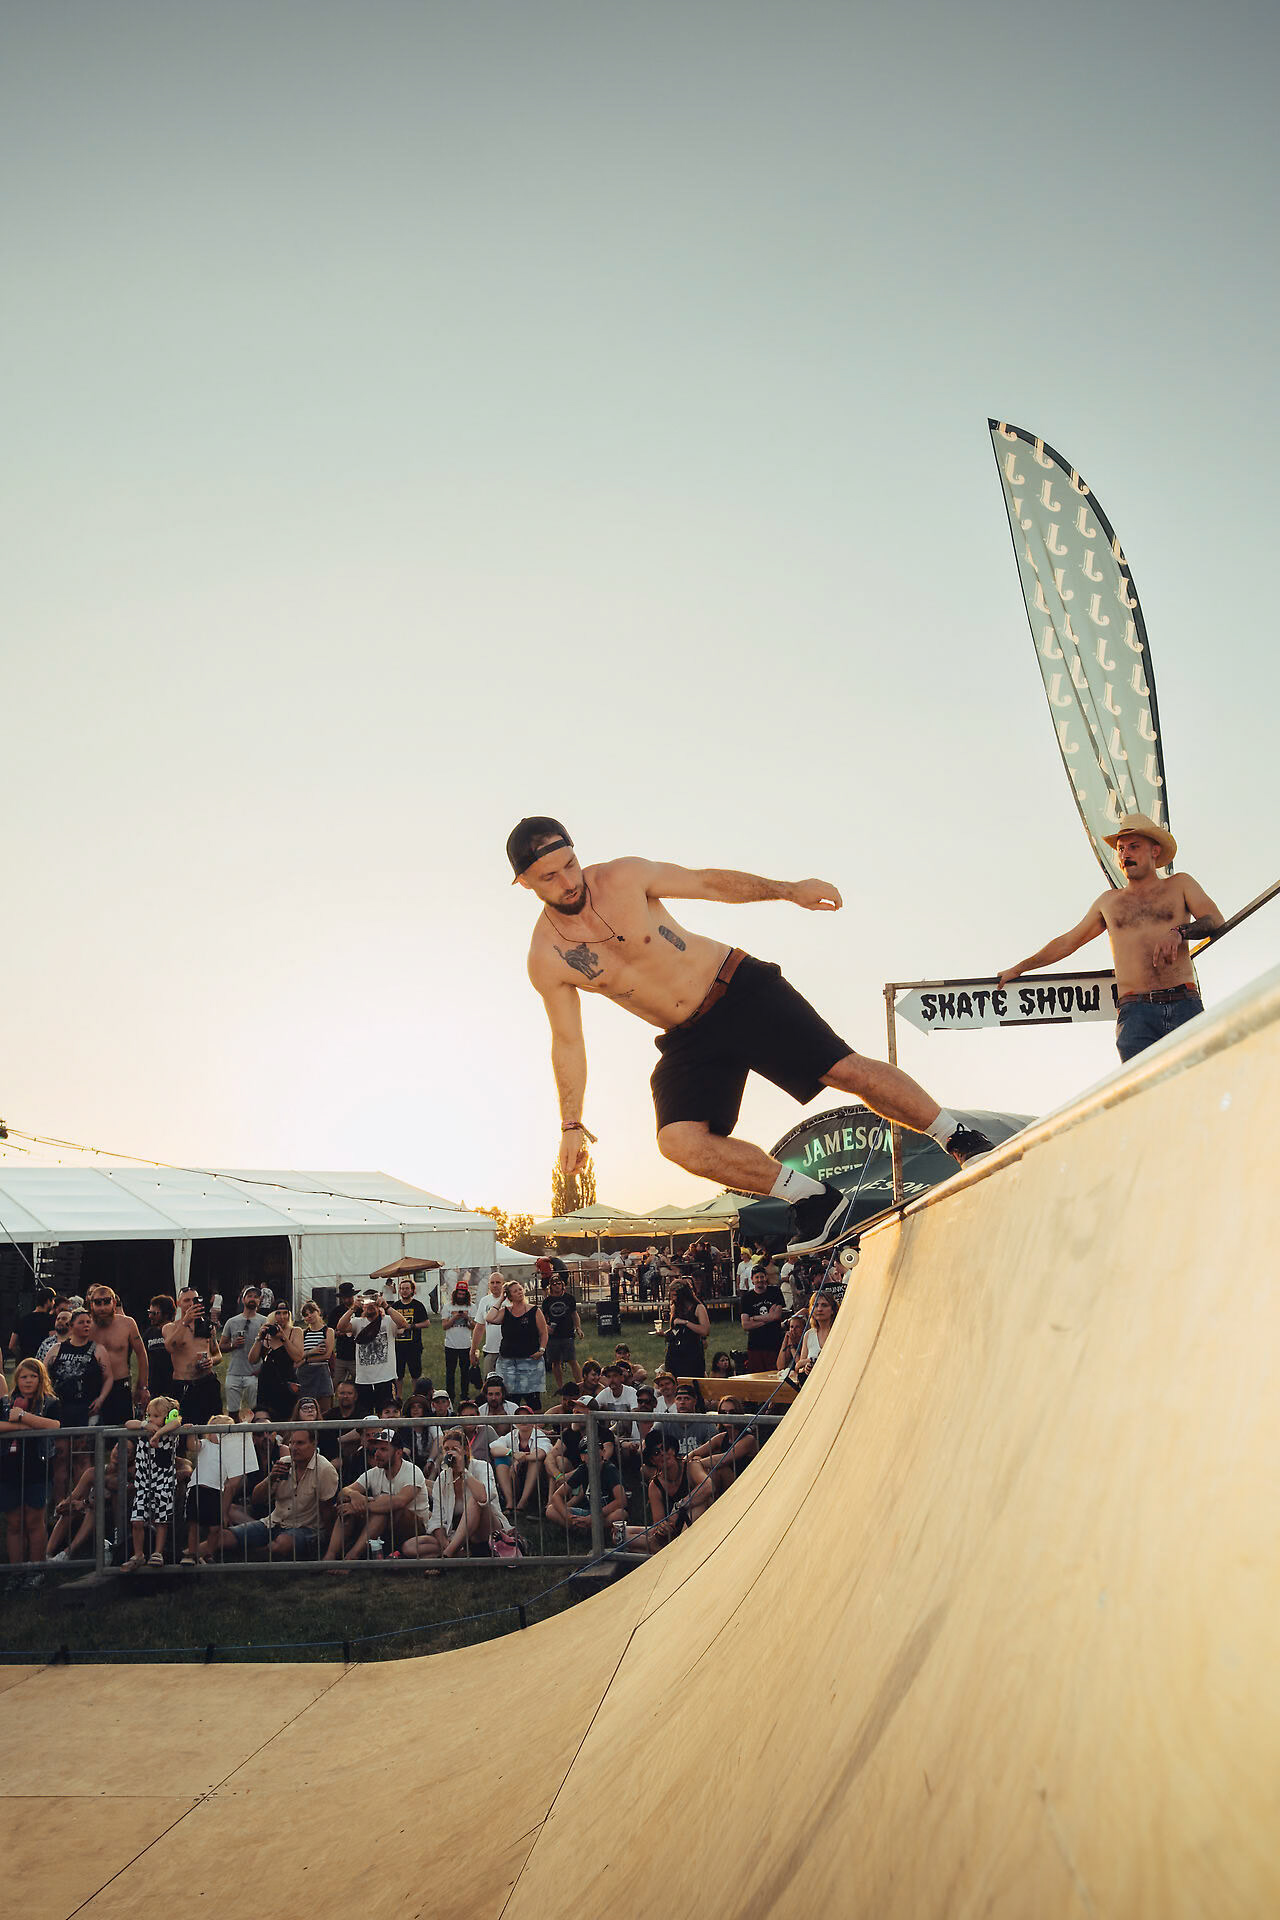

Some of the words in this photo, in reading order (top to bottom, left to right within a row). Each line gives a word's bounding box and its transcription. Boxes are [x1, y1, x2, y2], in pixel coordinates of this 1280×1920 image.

[920, 989, 1007, 1021] SKATE
[1018, 984, 1100, 1016] SHOW
[802, 1126, 894, 1168] JAMESON
